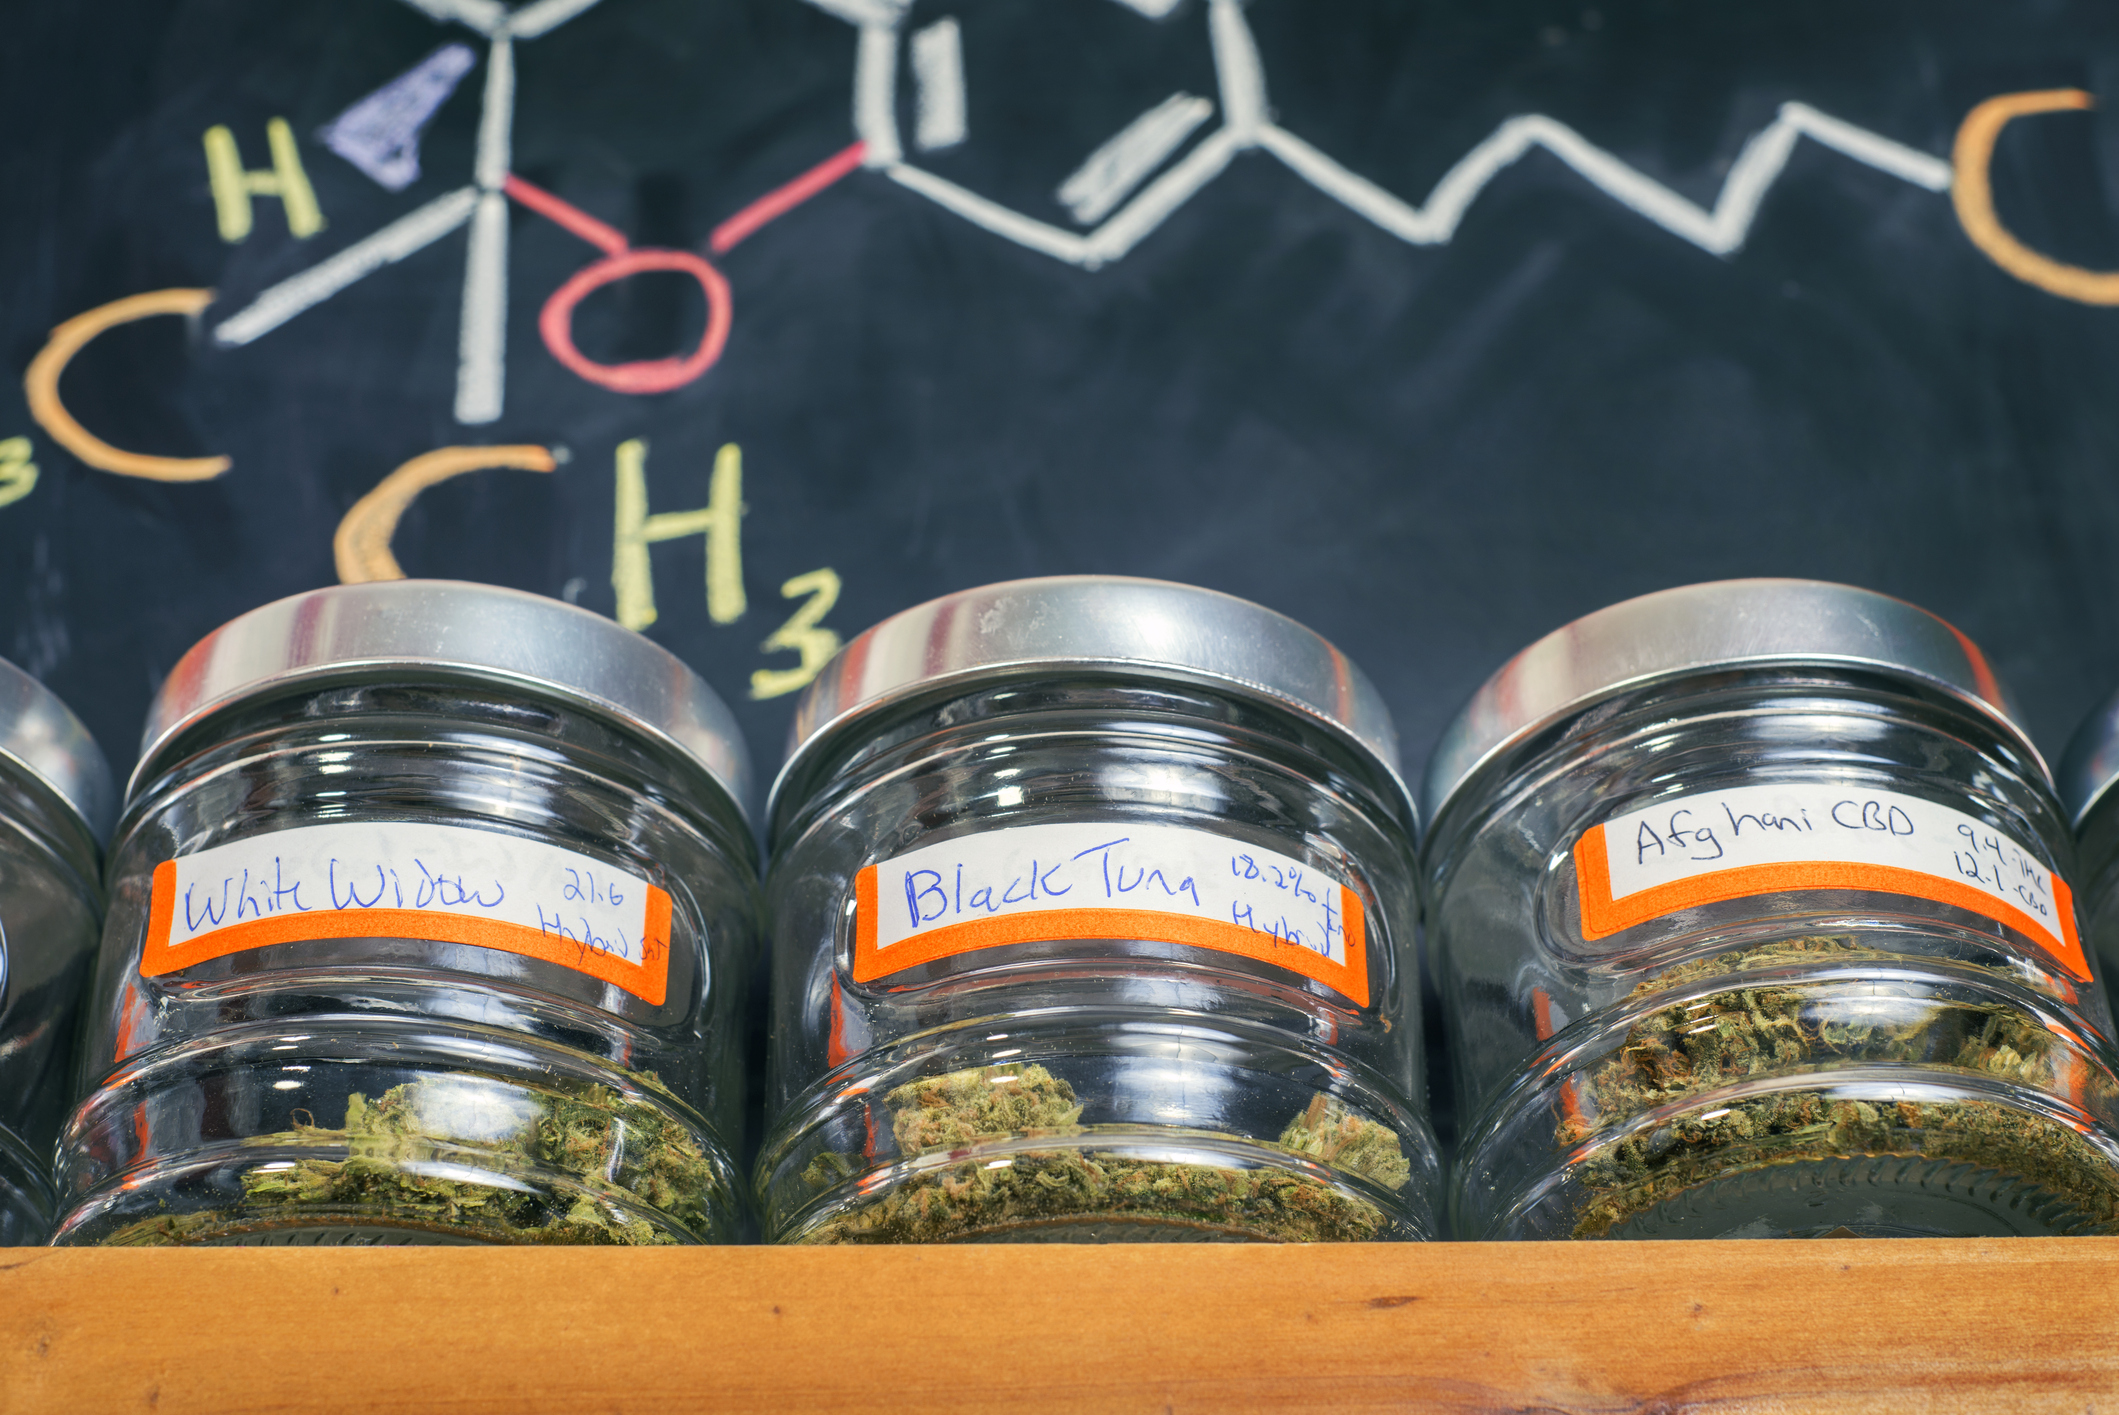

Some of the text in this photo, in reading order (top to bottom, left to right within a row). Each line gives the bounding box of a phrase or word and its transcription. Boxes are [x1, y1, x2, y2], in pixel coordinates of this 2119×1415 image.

[204, 117, 326, 242] H
[1636, 800, 1915, 865] Afghani CBD
[185, 856, 312, 932] White
[563, 867, 624, 906] 21.6
[905, 838, 1201, 928] Black Tuna
[1232, 854, 1317, 903] 18.2%
